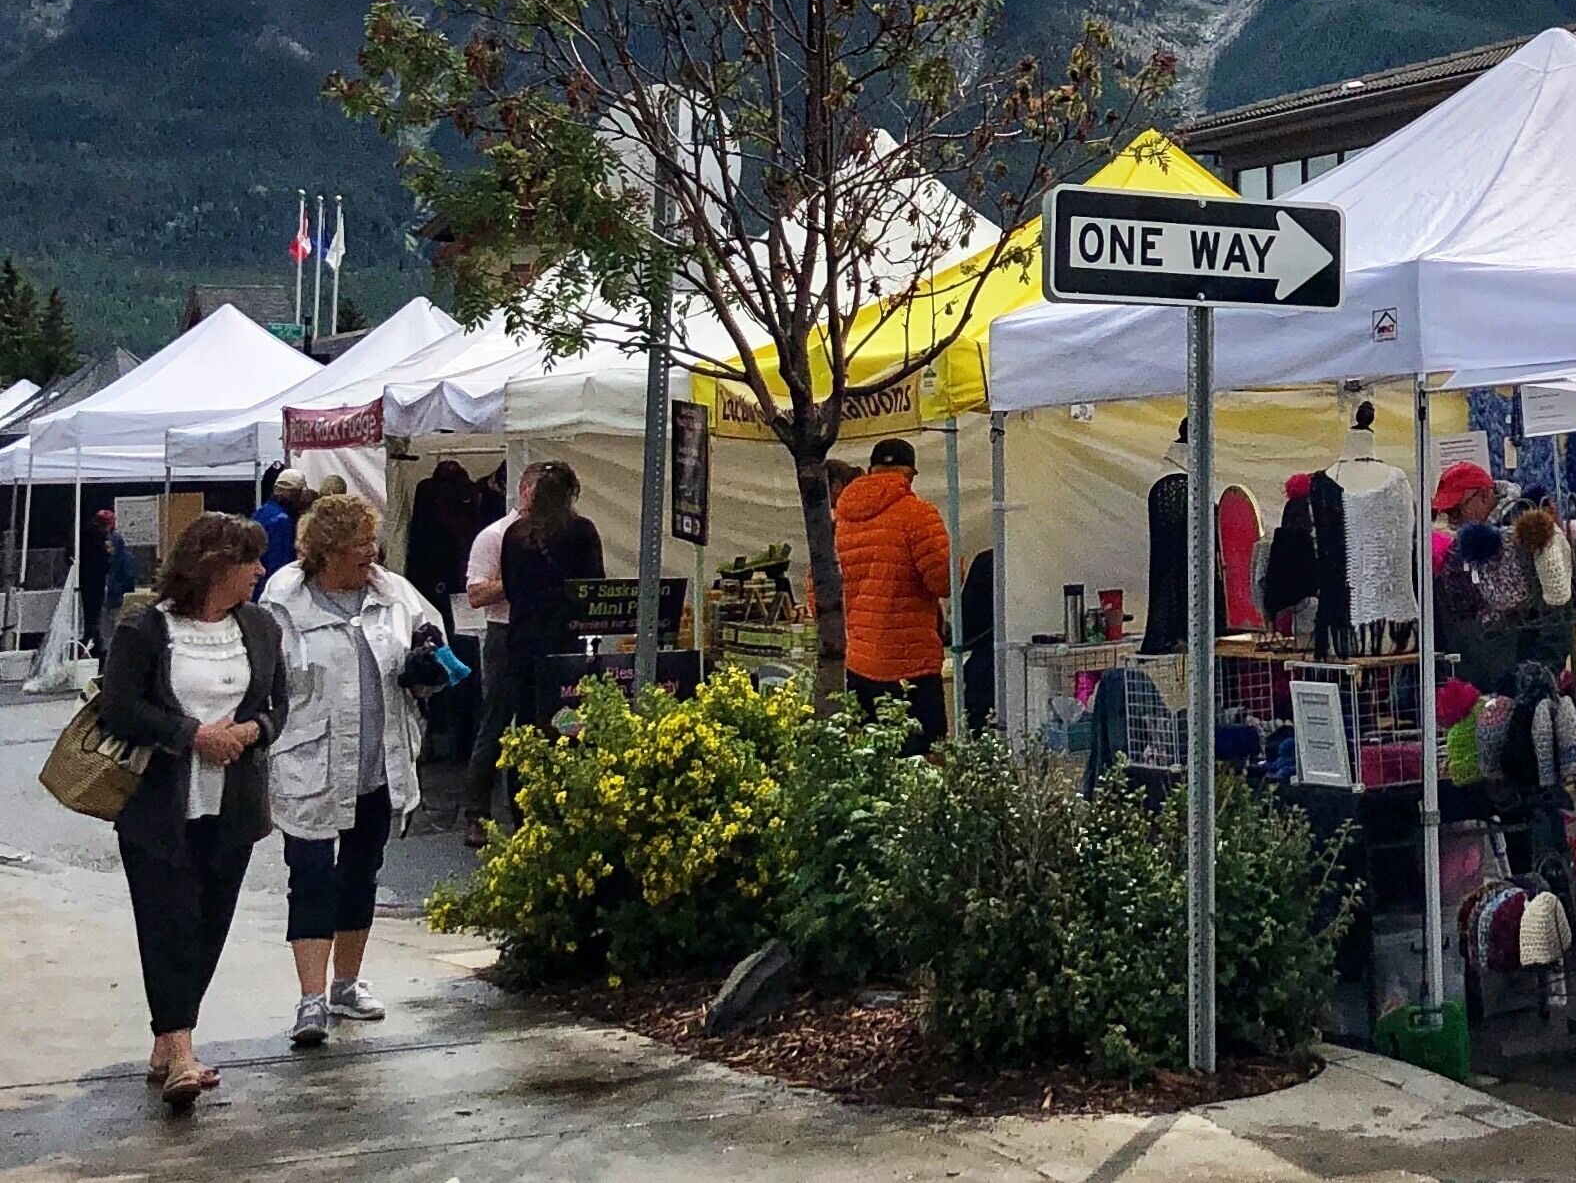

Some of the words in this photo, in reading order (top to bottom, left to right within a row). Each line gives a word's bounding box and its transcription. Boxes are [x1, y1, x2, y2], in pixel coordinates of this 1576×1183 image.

[1078, 222, 1164, 267] ONE
[1189, 229, 1277, 274] WAY
[342, 408, 377, 442] Fudge
[588, 602, 622, 616] Mini
